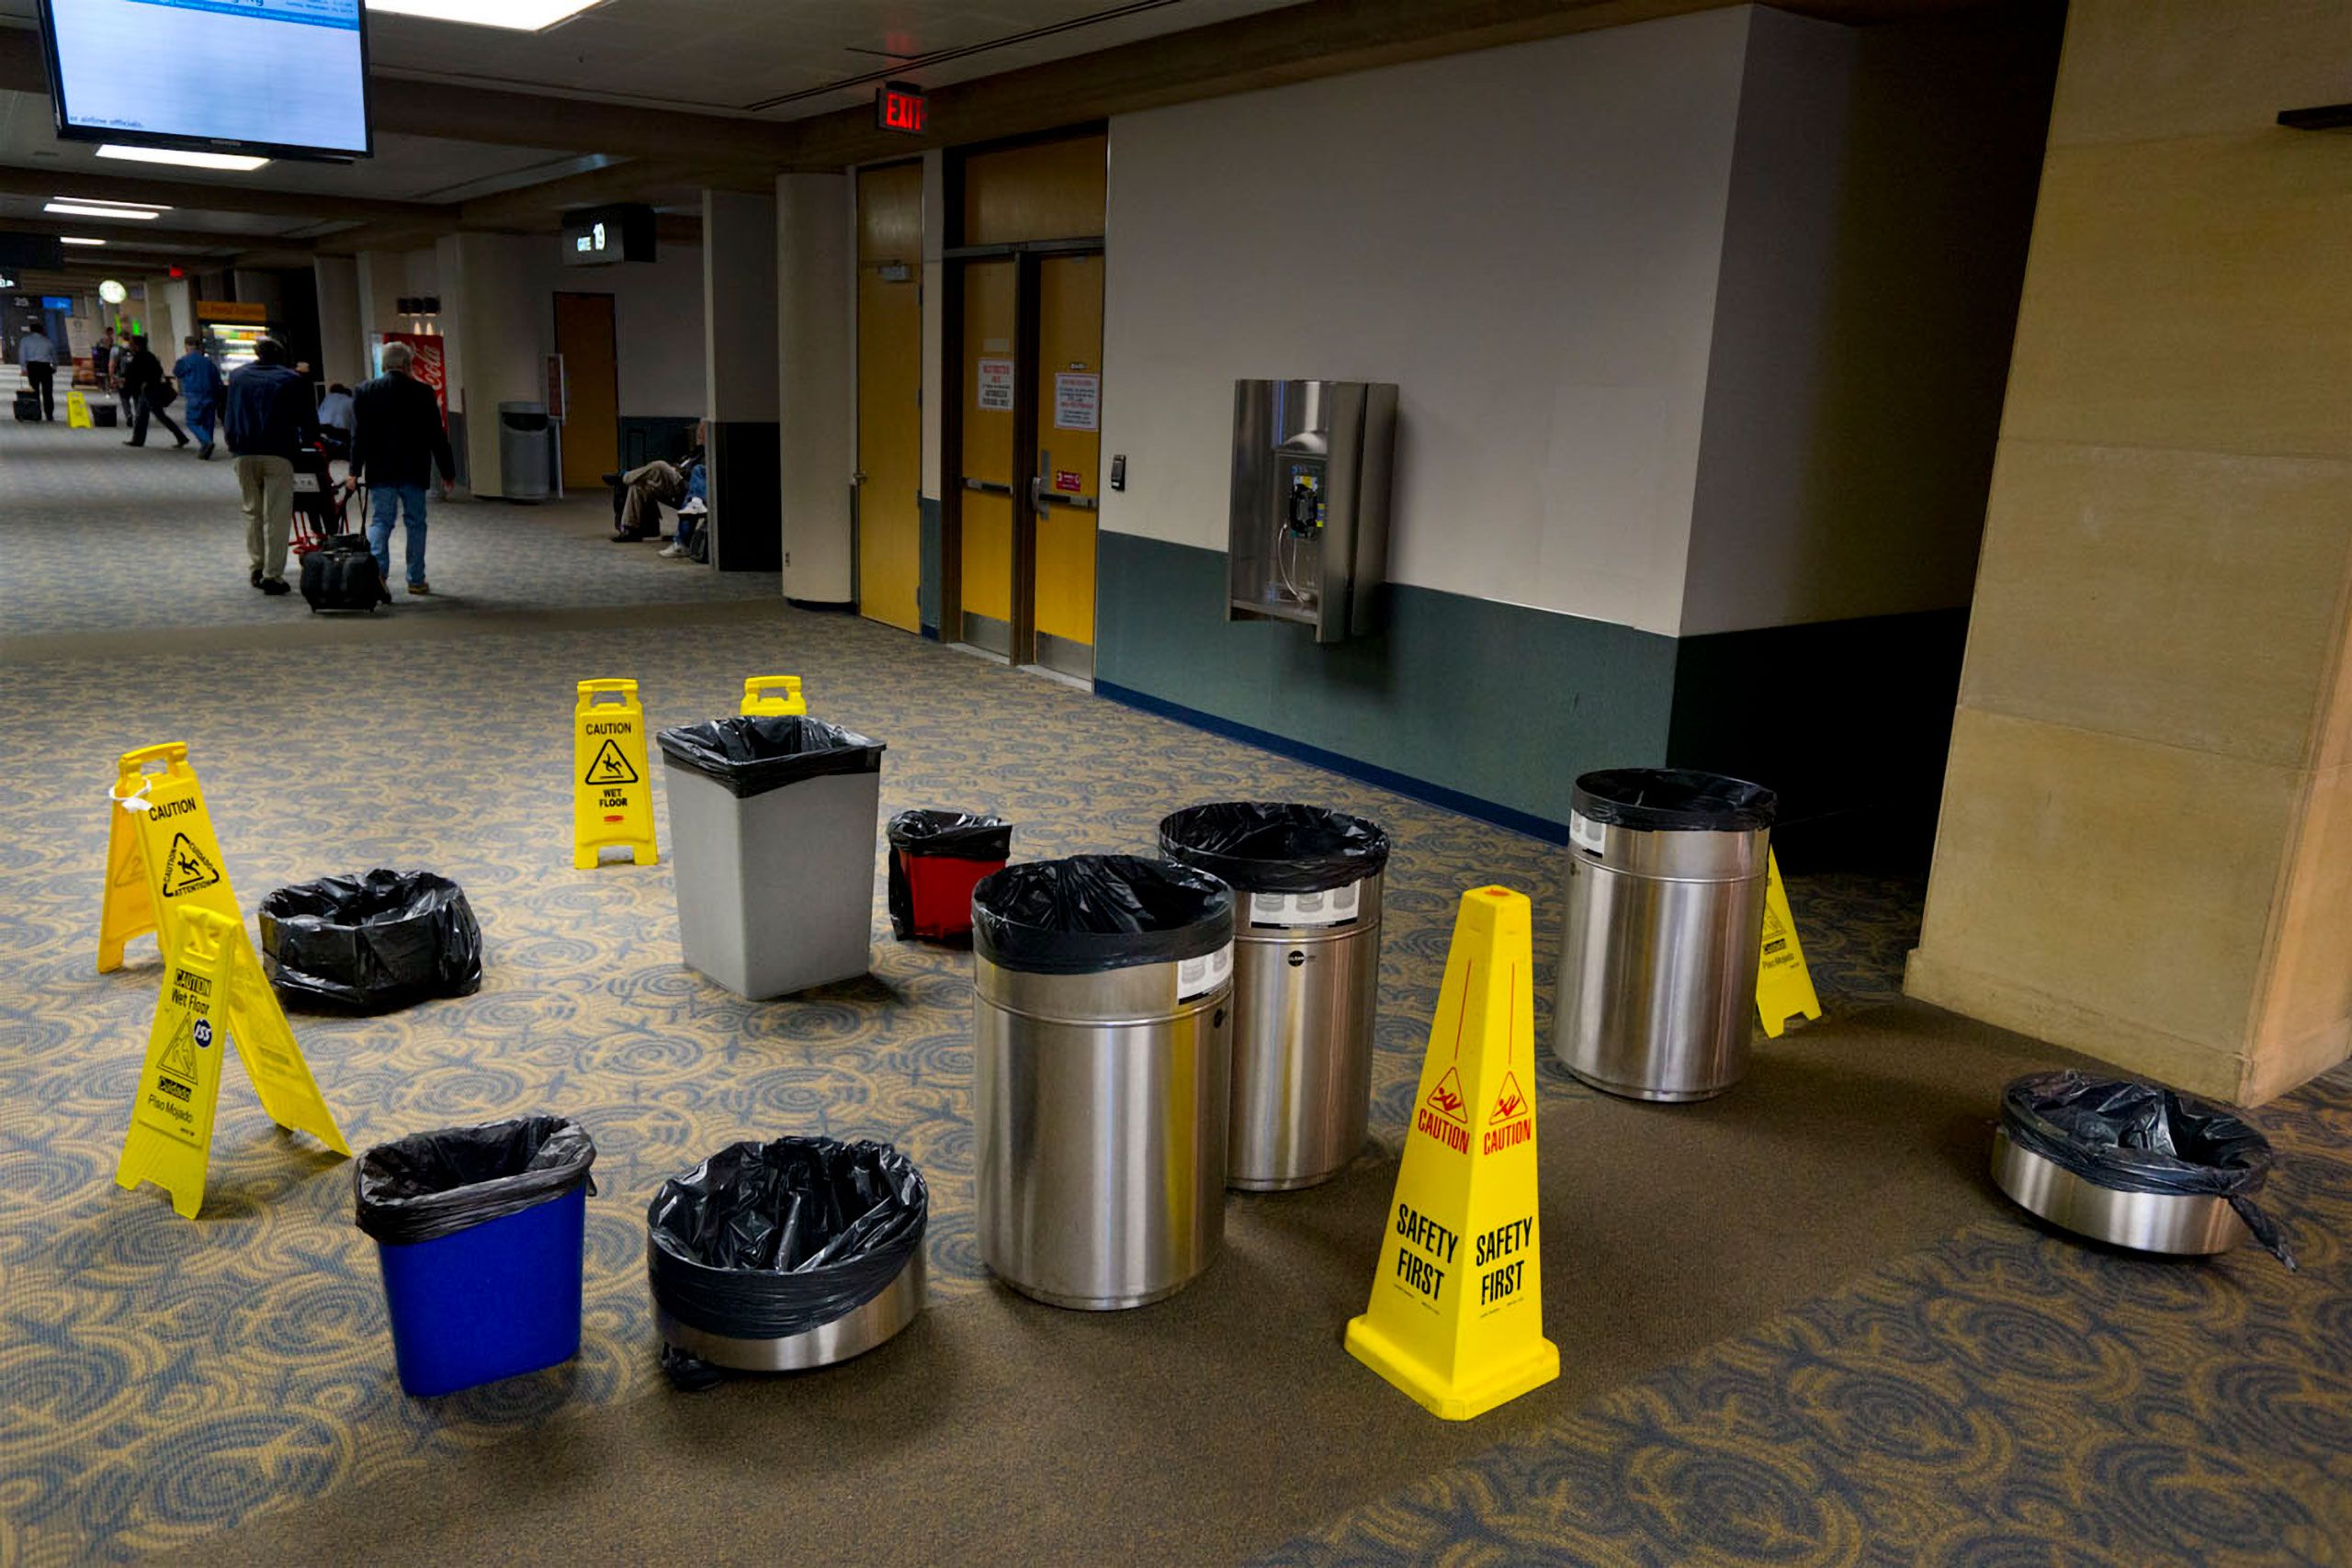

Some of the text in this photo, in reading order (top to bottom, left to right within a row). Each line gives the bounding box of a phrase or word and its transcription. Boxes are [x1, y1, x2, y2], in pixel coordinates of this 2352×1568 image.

[885, 91, 922, 131] EXIT
[585, 722, 632, 736] CAUTION
[149, 796, 197, 821] CAUTION
[599, 797, 628, 807] FLOOR
[603, 788, 623, 798] WET
[175, 969, 210, 998] CAUTION
[172, 987, 210, 1016] Wet Floor
[148, 1093, 165, 1111] Piso
[1418, 1108, 1470, 1155] CAUTION
[1484, 1117, 1532, 1156] CAUTION
[1396, 1203, 1458, 1264] SAFETY
[1476, 1216, 1532, 1267] SAFETY
[1396, 1247, 1445, 1301] FIRST
[1481, 1259, 1525, 1305] FIRST
